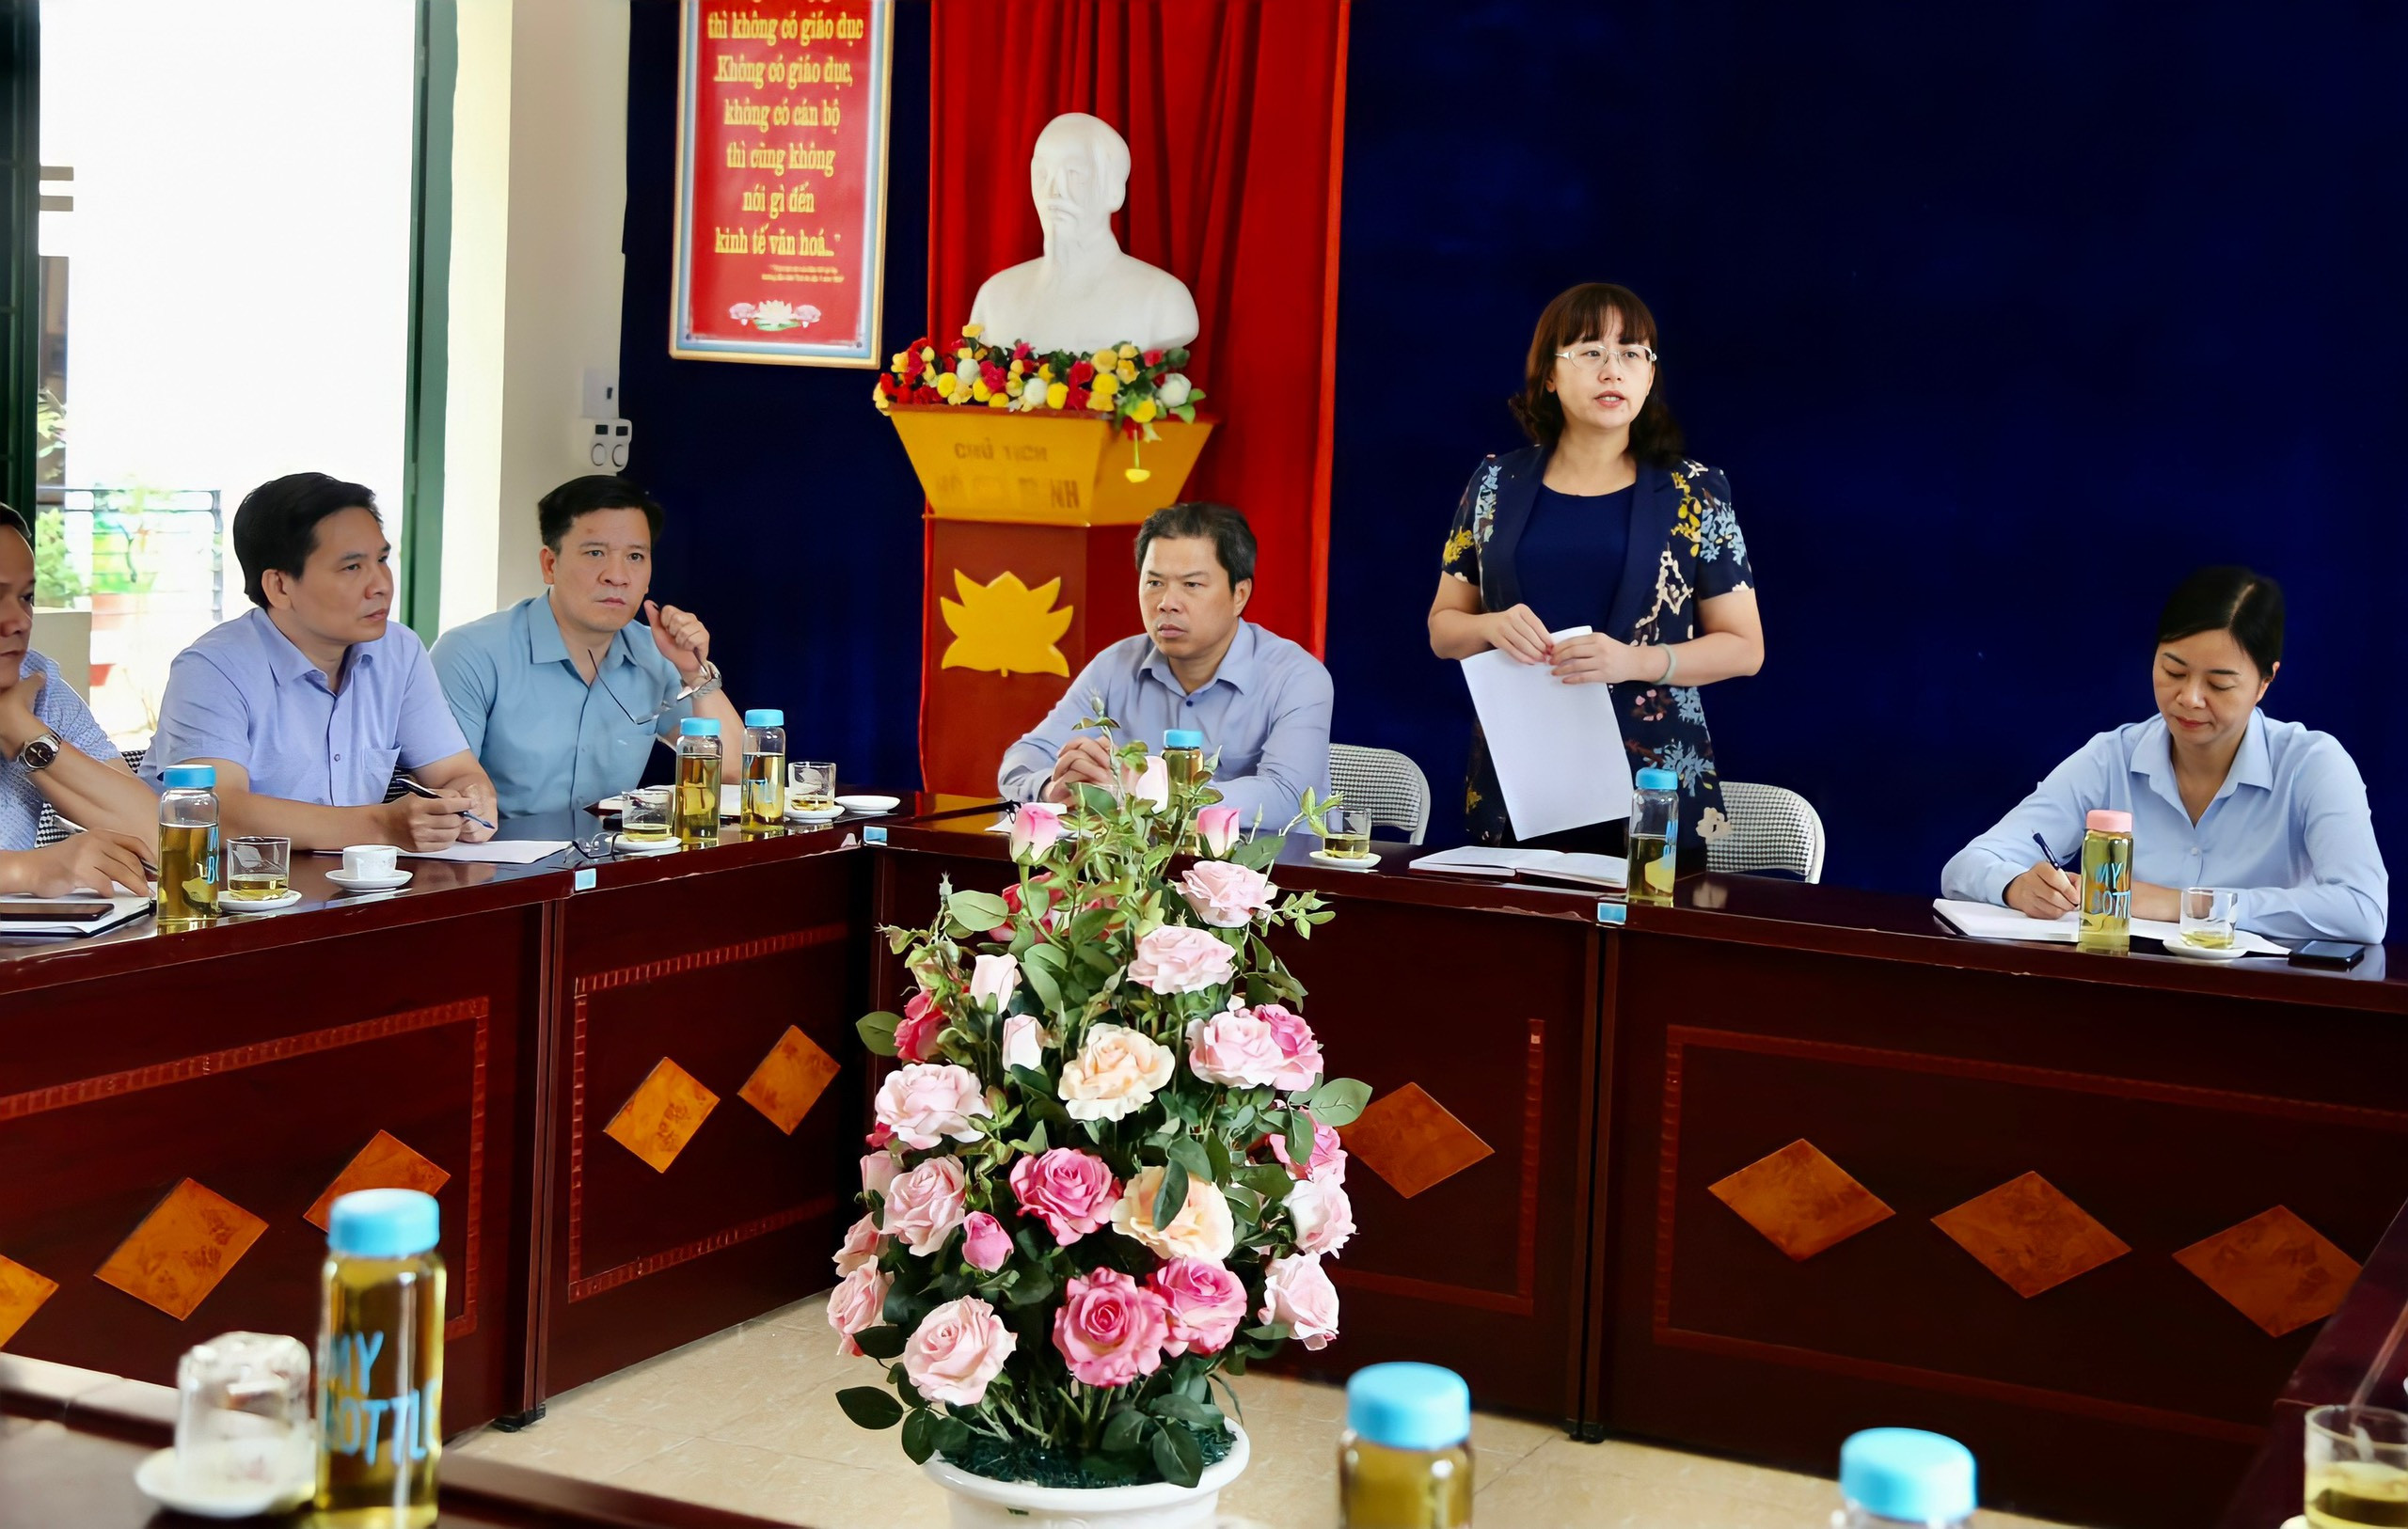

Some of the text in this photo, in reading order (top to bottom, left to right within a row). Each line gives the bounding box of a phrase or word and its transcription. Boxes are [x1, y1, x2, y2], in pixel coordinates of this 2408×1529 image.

[707, 10, 727, 39] thì
[732, 10, 778, 46] không
[781, 10, 798, 39] có
[801, 10, 833, 46] giáo
[768, 54, 785, 83] có
[787, 54, 821, 89] giáo
[723, 97, 840, 134] không có cán bộ
[726, 140, 836, 178] thì cũng không
[742, 181, 816, 219] nói gì đến
[715, 227, 749, 254] kinh
[752, 223, 769, 254] tế
[769, 229, 796, 255] văn
